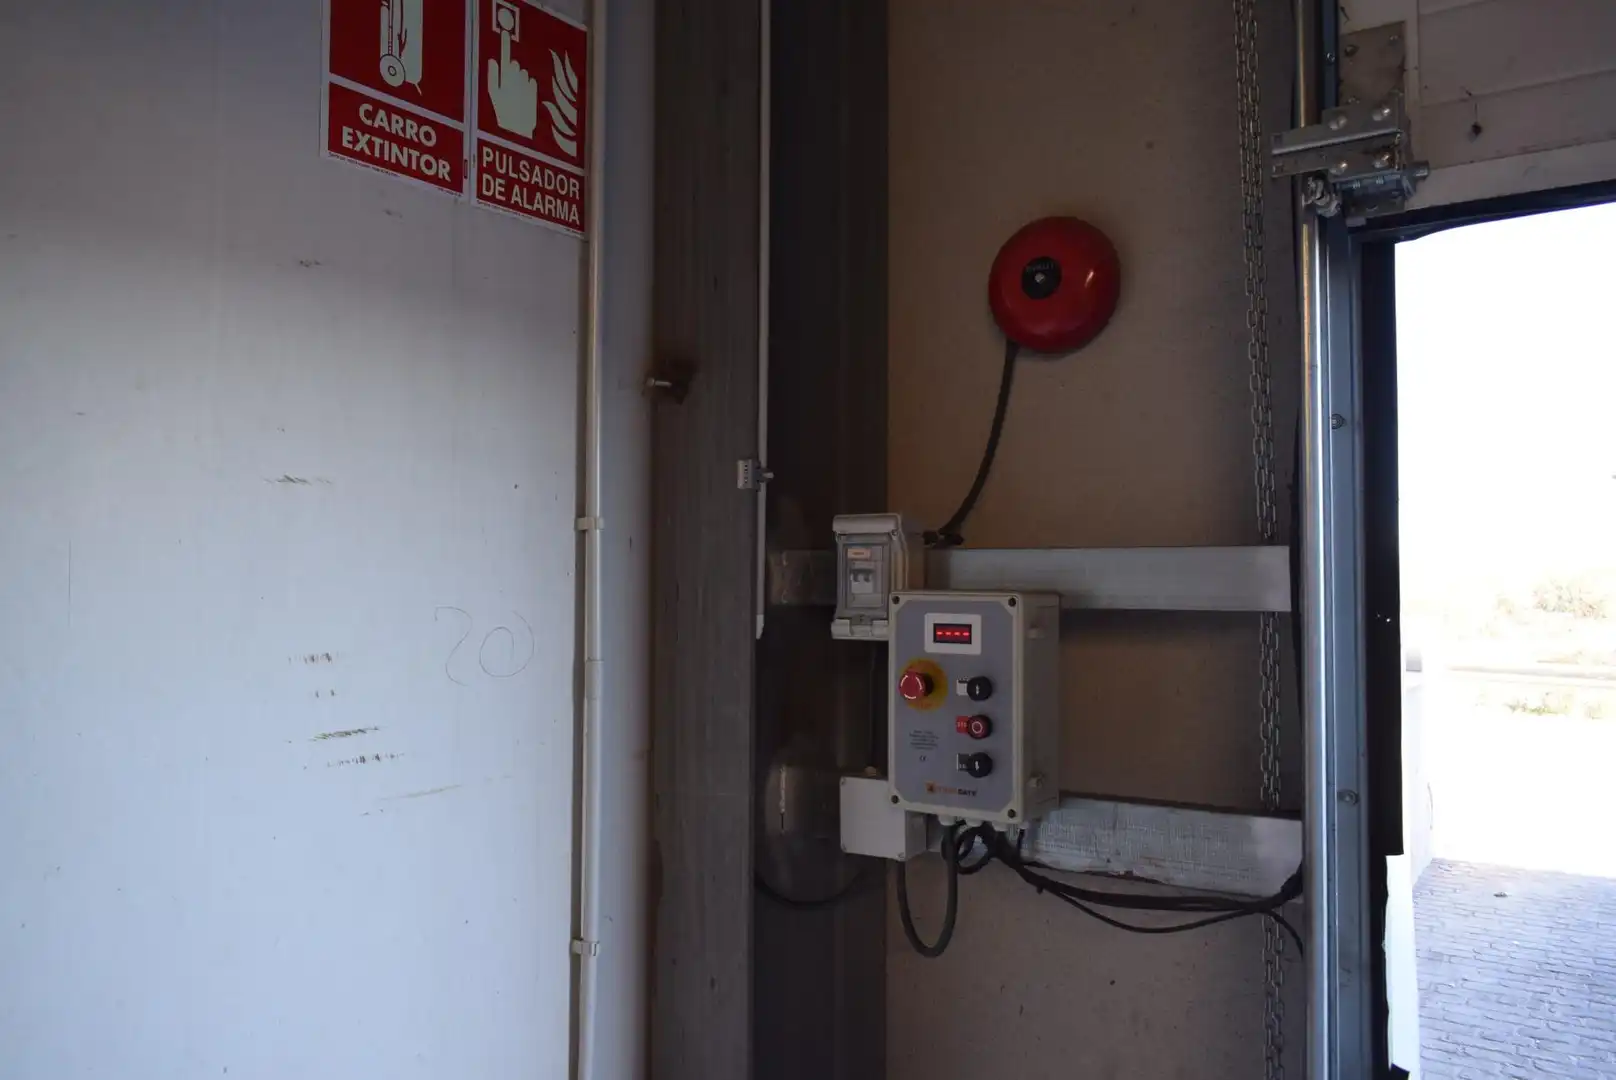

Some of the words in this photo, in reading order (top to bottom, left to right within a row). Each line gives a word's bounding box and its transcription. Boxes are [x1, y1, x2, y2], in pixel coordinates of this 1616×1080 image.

[359, 103, 437, 147] CARRO
[342, 126, 451, 182] EXTINTOR
[482, 145, 580, 200] PULSADOR
[482, 173, 506, 200] DE
[511, 184, 580, 225] ALARMA
